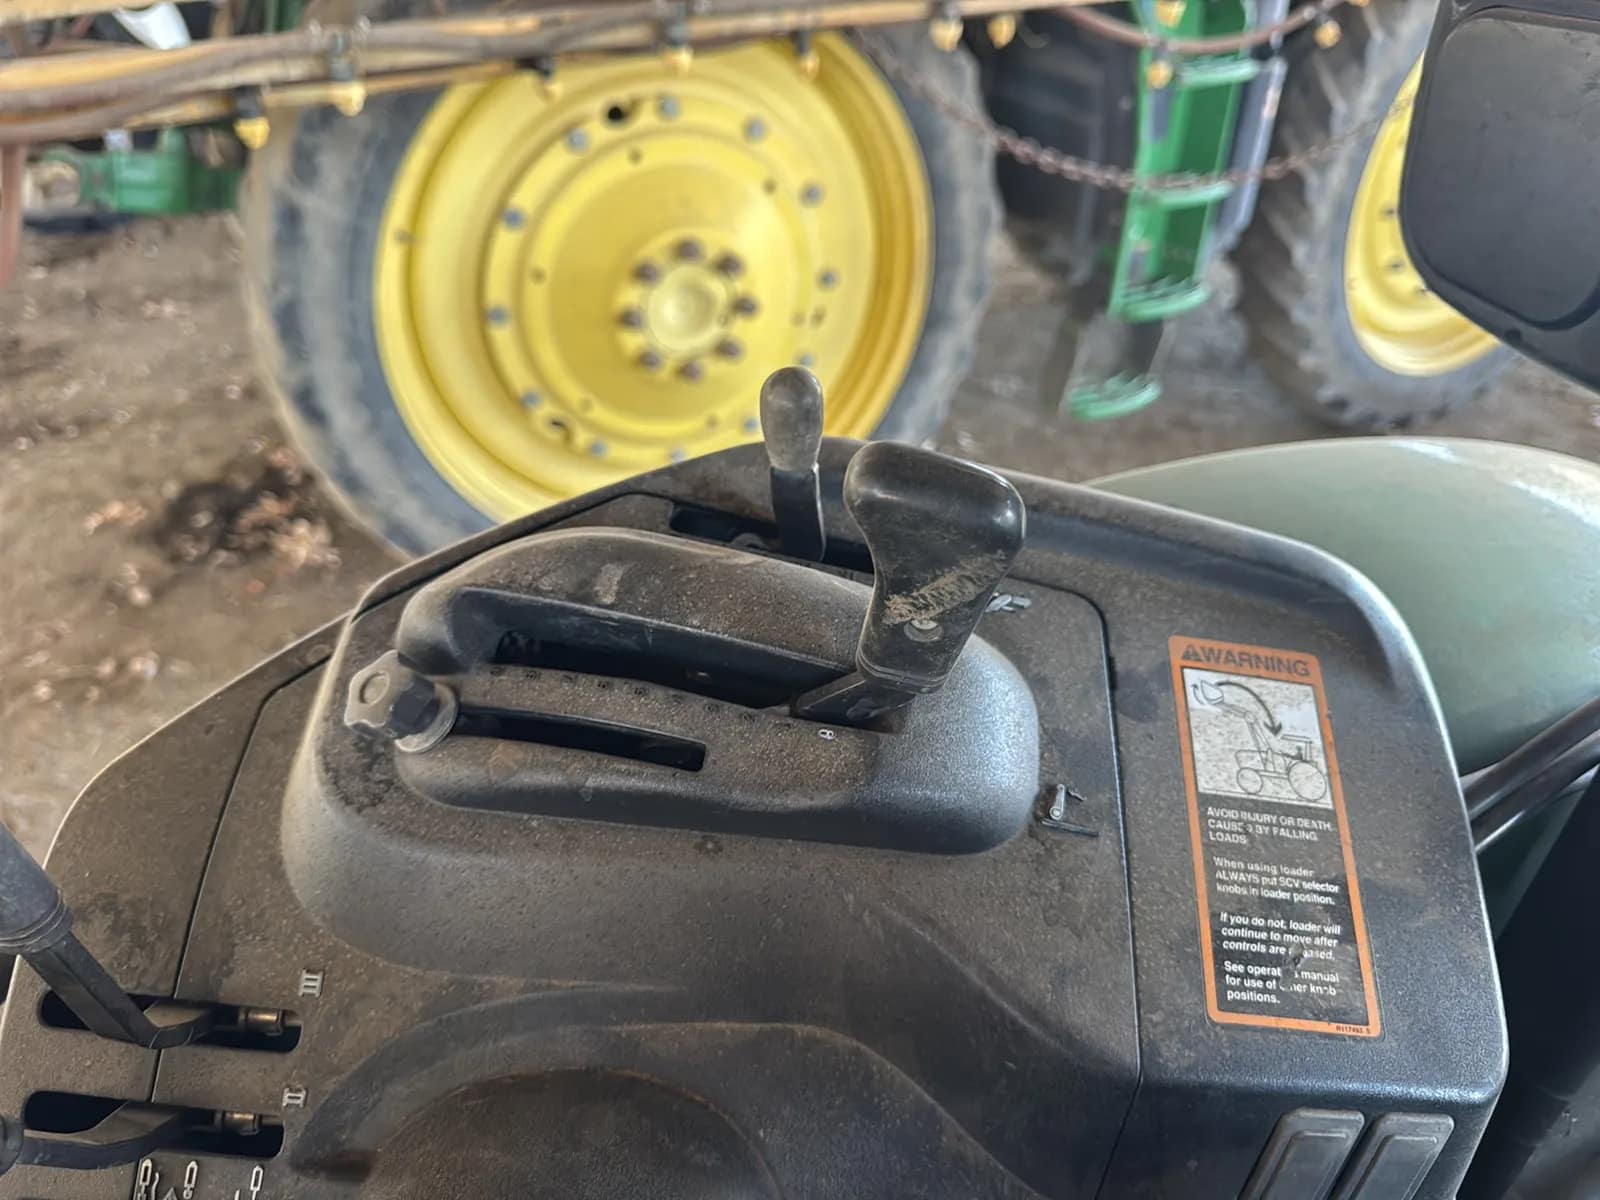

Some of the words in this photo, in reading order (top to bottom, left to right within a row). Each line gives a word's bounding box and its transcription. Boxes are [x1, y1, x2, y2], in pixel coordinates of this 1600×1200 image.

[1200, 647, 1310, 676] WARNING
[1207, 806, 1239, 820] AVOID
[1240, 810, 1277, 824] INJURY
[1279, 815, 1295, 826] OR
[1271, 825, 1319, 841] FALLING
[1213, 856, 1244, 869] When
[1247, 862, 1277, 876] using
[1280, 865, 1314, 878] loader
[1215, 870, 1260, 884] ALWAYS
[1261, 875, 1277, 887] put
[1279, 876, 1300, 888] SCV
[1301, 879, 1339, 893] selector
[1216, 883, 1248, 896] knobs
[1249, 885, 1259, 897] in
[1261, 887, 1291, 900] loader
[1293, 891, 1336, 905] position.
[1220, 911, 1230, 923] If
[1230, 913, 1249, 926] you
[1251, 915, 1265, 927] do
[1267, 917, 1287, 929] not,
[1289, 919, 1322, 933] loader
[1323, 924, 1341, 935] will
[1221, 926, 1268, 940] continue
[1269, 930, 1281, 941] to
[1283, 933, 1312, 944] move
[1313, 934, 1339, 948] after
[1222, 939, 1266, 954] controls
[1268, 945, 1287, 956] are
[1288, 947, 1336, 961] rased.
[1223, 960, 1244, 973] See
[1246, 963, 1299, 978] operat
[1300, 970, 1340, 983] manual
[1225, 974, 1240, 986] for
[1243, 978, 1263, 988] use
[1265, 979, 1276, 990] of
[1279, 980, 1308, 993] her
[1226, 990, 1281, 1004] positions.
